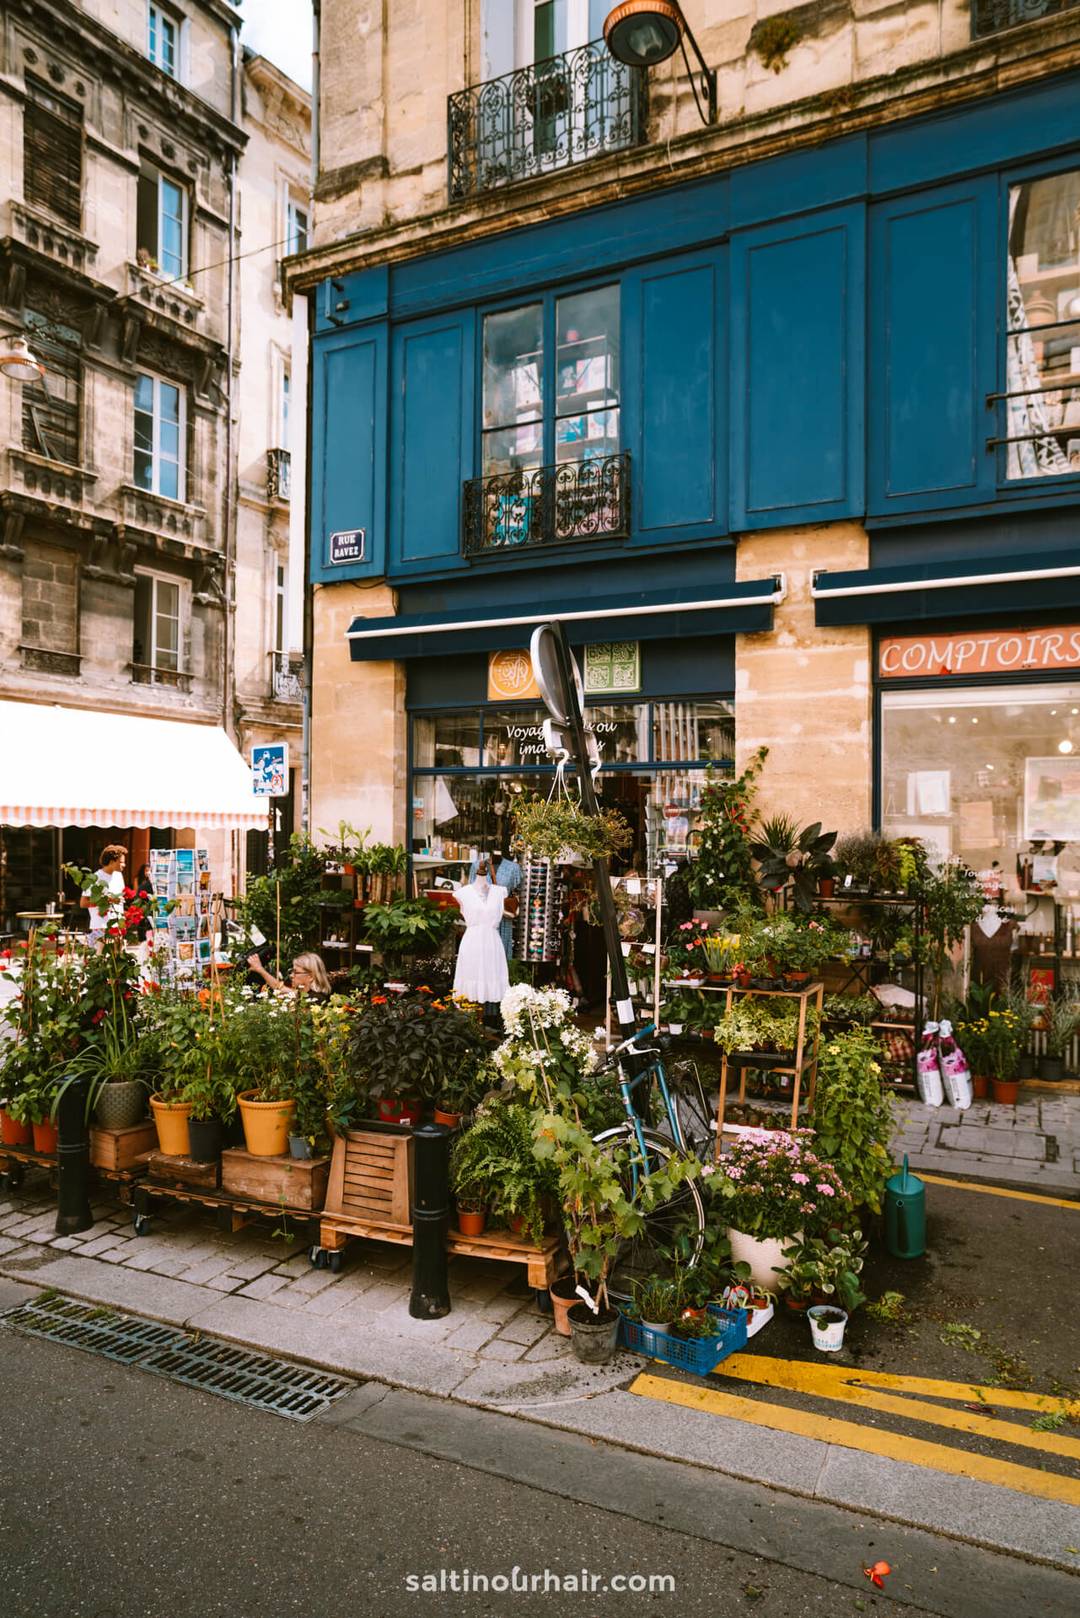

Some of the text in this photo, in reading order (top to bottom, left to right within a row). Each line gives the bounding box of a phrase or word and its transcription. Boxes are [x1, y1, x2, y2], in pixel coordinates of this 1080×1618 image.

[338, 534, 356, 546] RUE
[334, 546, 359, 558] RAVEZ
[881, 632, 1080, 672] COMPTOIRS
[506, 725, 545, 741] Voyag
[596, 722, 618, 733] ou
